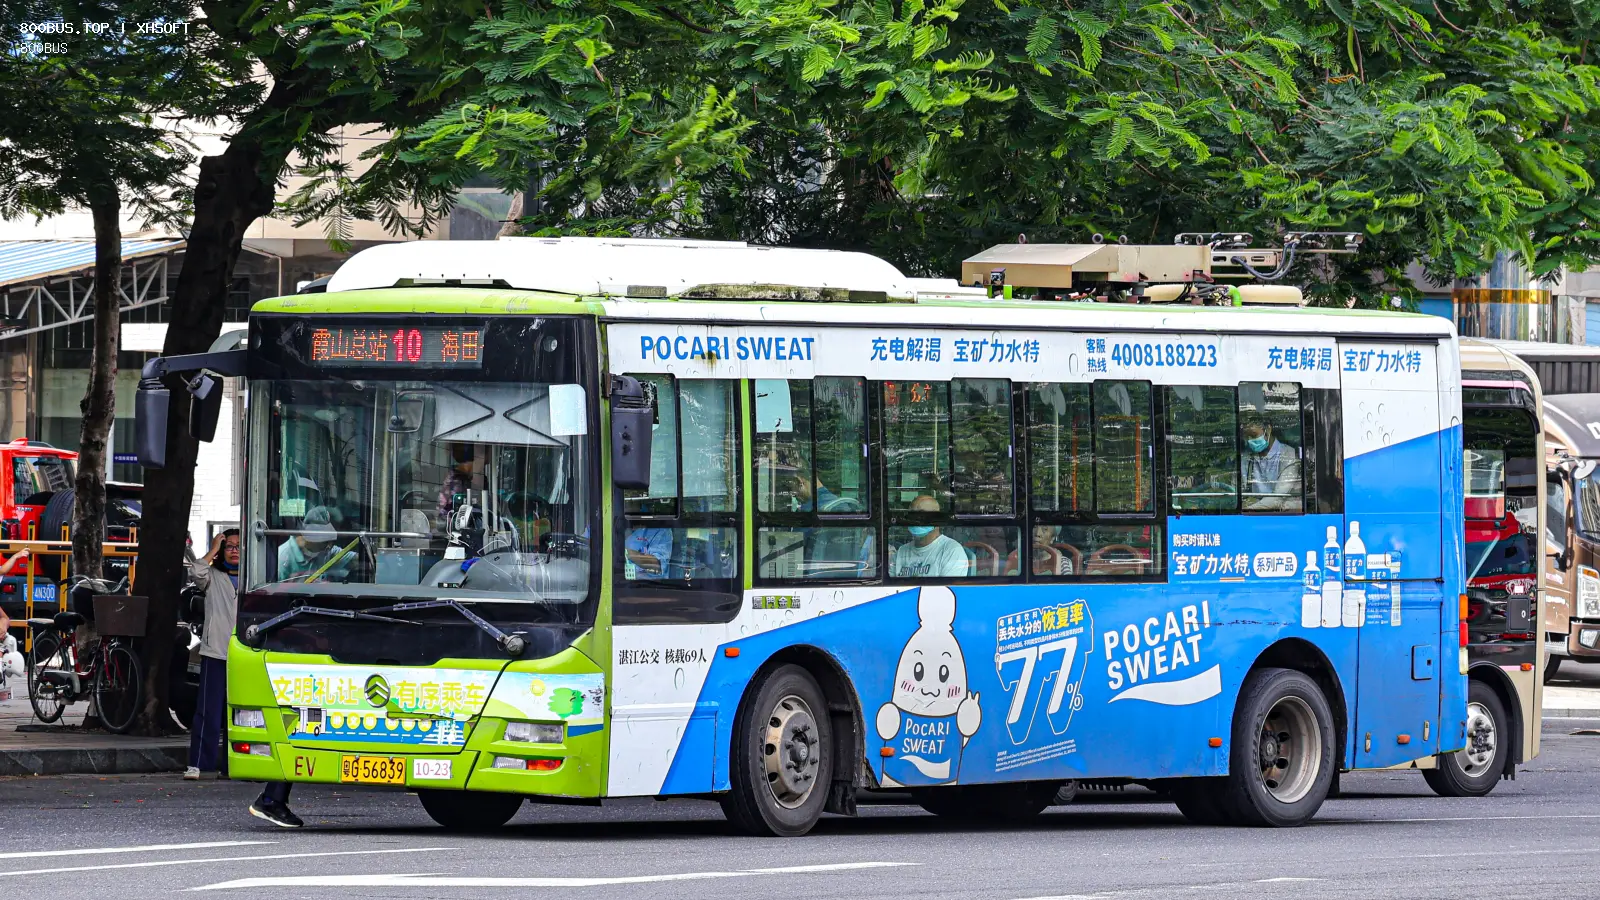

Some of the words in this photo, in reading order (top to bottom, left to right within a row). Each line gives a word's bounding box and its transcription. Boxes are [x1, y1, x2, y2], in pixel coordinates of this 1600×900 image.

[312, 328, 387, 361] 霞山总站
[392, 329, 422, 362] 10
[441, 330, 479, 362] 海田
[640, 335, 730, 360] POCARI
[736, 336, 815, 361] SWEAT
[870, 336, 942, 362] 充电解渴
[953, 338, 1040, 363] 宝矿力水特
[1086, 338, 1106, 354] 客服
[1111, 343, 1218, 368] 4008188223
[1087, 357, 1107, 373] 热线
[1267, 346, 1332, 371] 充电解渴
[1343, 350, 1422, 373] 宝矿力水特
[1172, 533, 1221, 547] 购买时请认准
[1256, 556, 1294, 572] 系列产品
[998, 619, 1041, 641] 丢失水分的
[1042, 602, 1084, 633] 恢复率
[1104, 600, 1211, 661] POCARI
[618, 648, 660, 665] 湛江公交
[664, 648, 707, 664] 核载69人
[1107, 634, 1203, 690] SWEAT
[272, 676, 359, 706] 文明礼让
[395, 680, 485, 709] 有序乘车
[905, 718, 950, 737] POCARI
[902, 737, 946, 755] SWEAT
[294, 755, 317, 777] EV
[414, 761, 450, 777] 10-23
